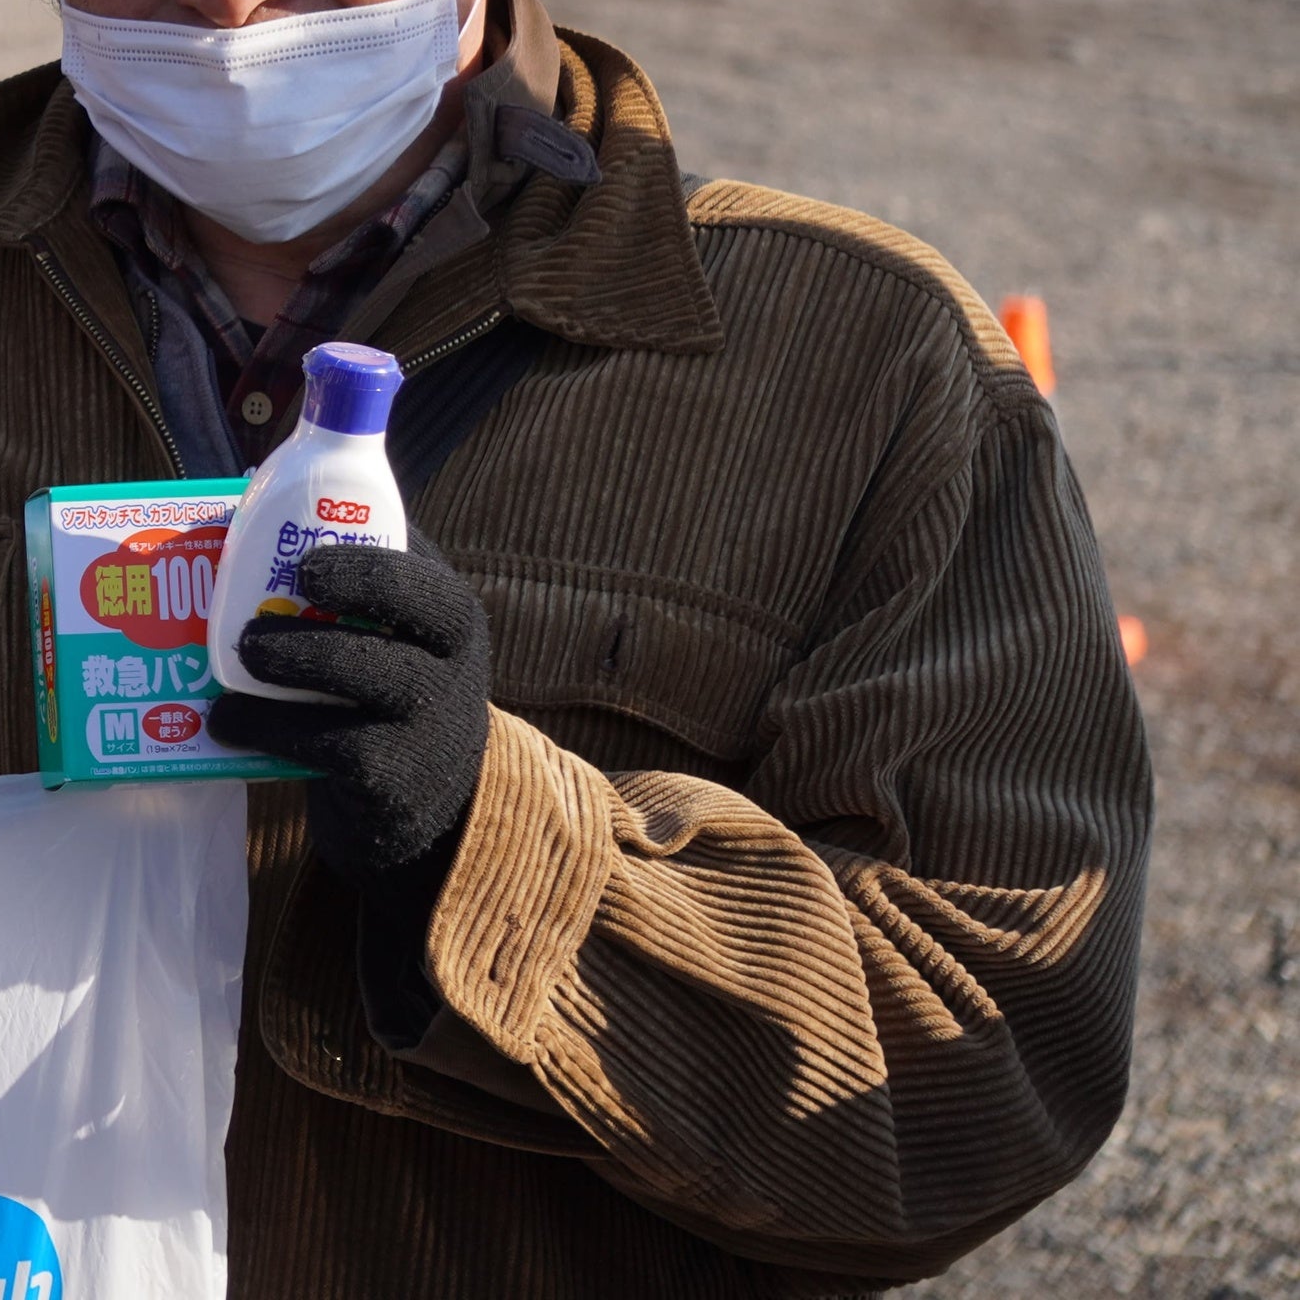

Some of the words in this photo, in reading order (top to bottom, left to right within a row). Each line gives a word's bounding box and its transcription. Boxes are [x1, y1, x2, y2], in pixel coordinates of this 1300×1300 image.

[95, 556, 218, 622] 徳用100
[82, 654, 211, 699] 救急バン
[105, 712, 135, 741] M
[147, 711, 195, 727] 一番良く
[157, 724, 189, 740] 使う!
[106, 740, 137, 754] サイズ
